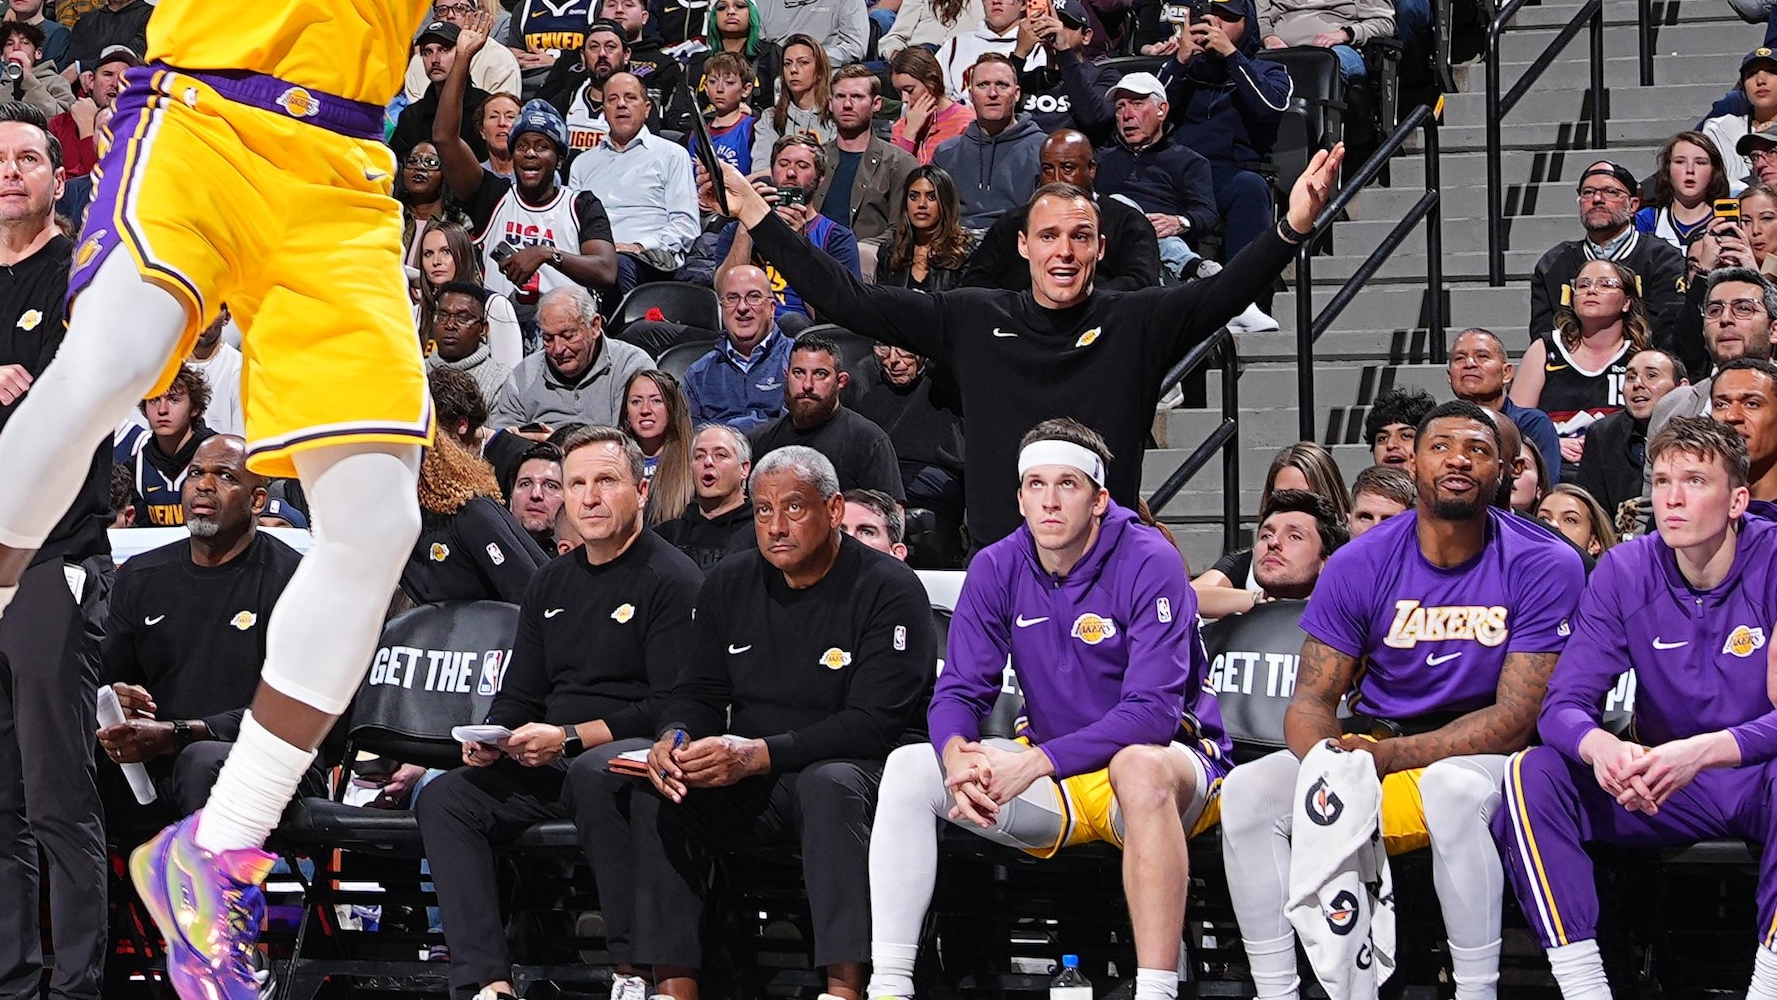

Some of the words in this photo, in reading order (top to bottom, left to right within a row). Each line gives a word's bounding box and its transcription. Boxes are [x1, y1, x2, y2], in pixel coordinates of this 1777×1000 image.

[525, 31, 587, 53] DENVER
[568, 130, 609, 149] UGGE
[505, 221, 555, 249] USA
[146, 503, 185, 526] DENV
[1382, 599, 1509, 649] LAKERS
[369, 645, 424, 690] GET
[425, 650, 475, 694] THE
[1210, 651, 1261, 696] GET
[1264, 652, 1300, 698] TH
